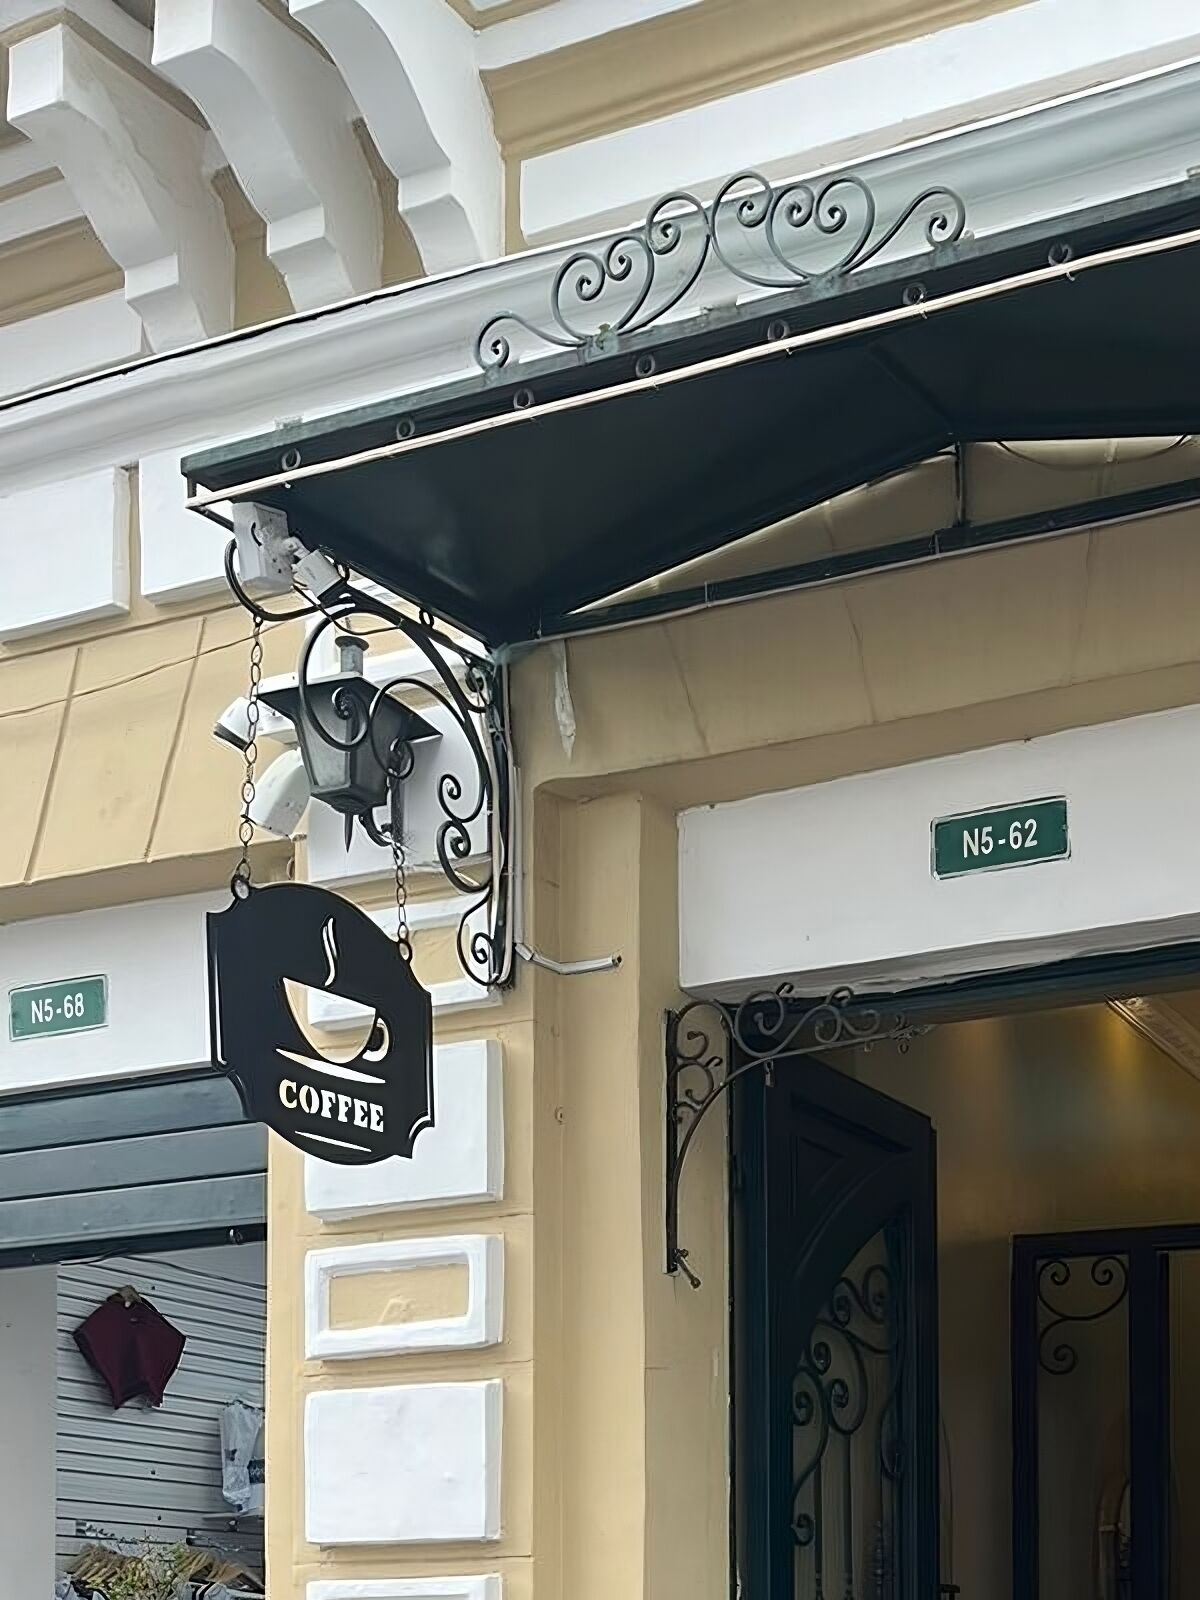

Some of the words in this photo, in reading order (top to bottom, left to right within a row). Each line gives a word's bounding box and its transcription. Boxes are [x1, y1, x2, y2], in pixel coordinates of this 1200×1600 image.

[963, 819, 1038, 858] N5-62
[30, 992, 85, 1024] N5-68
[278, 1078, 385, 1133] COFFEE
